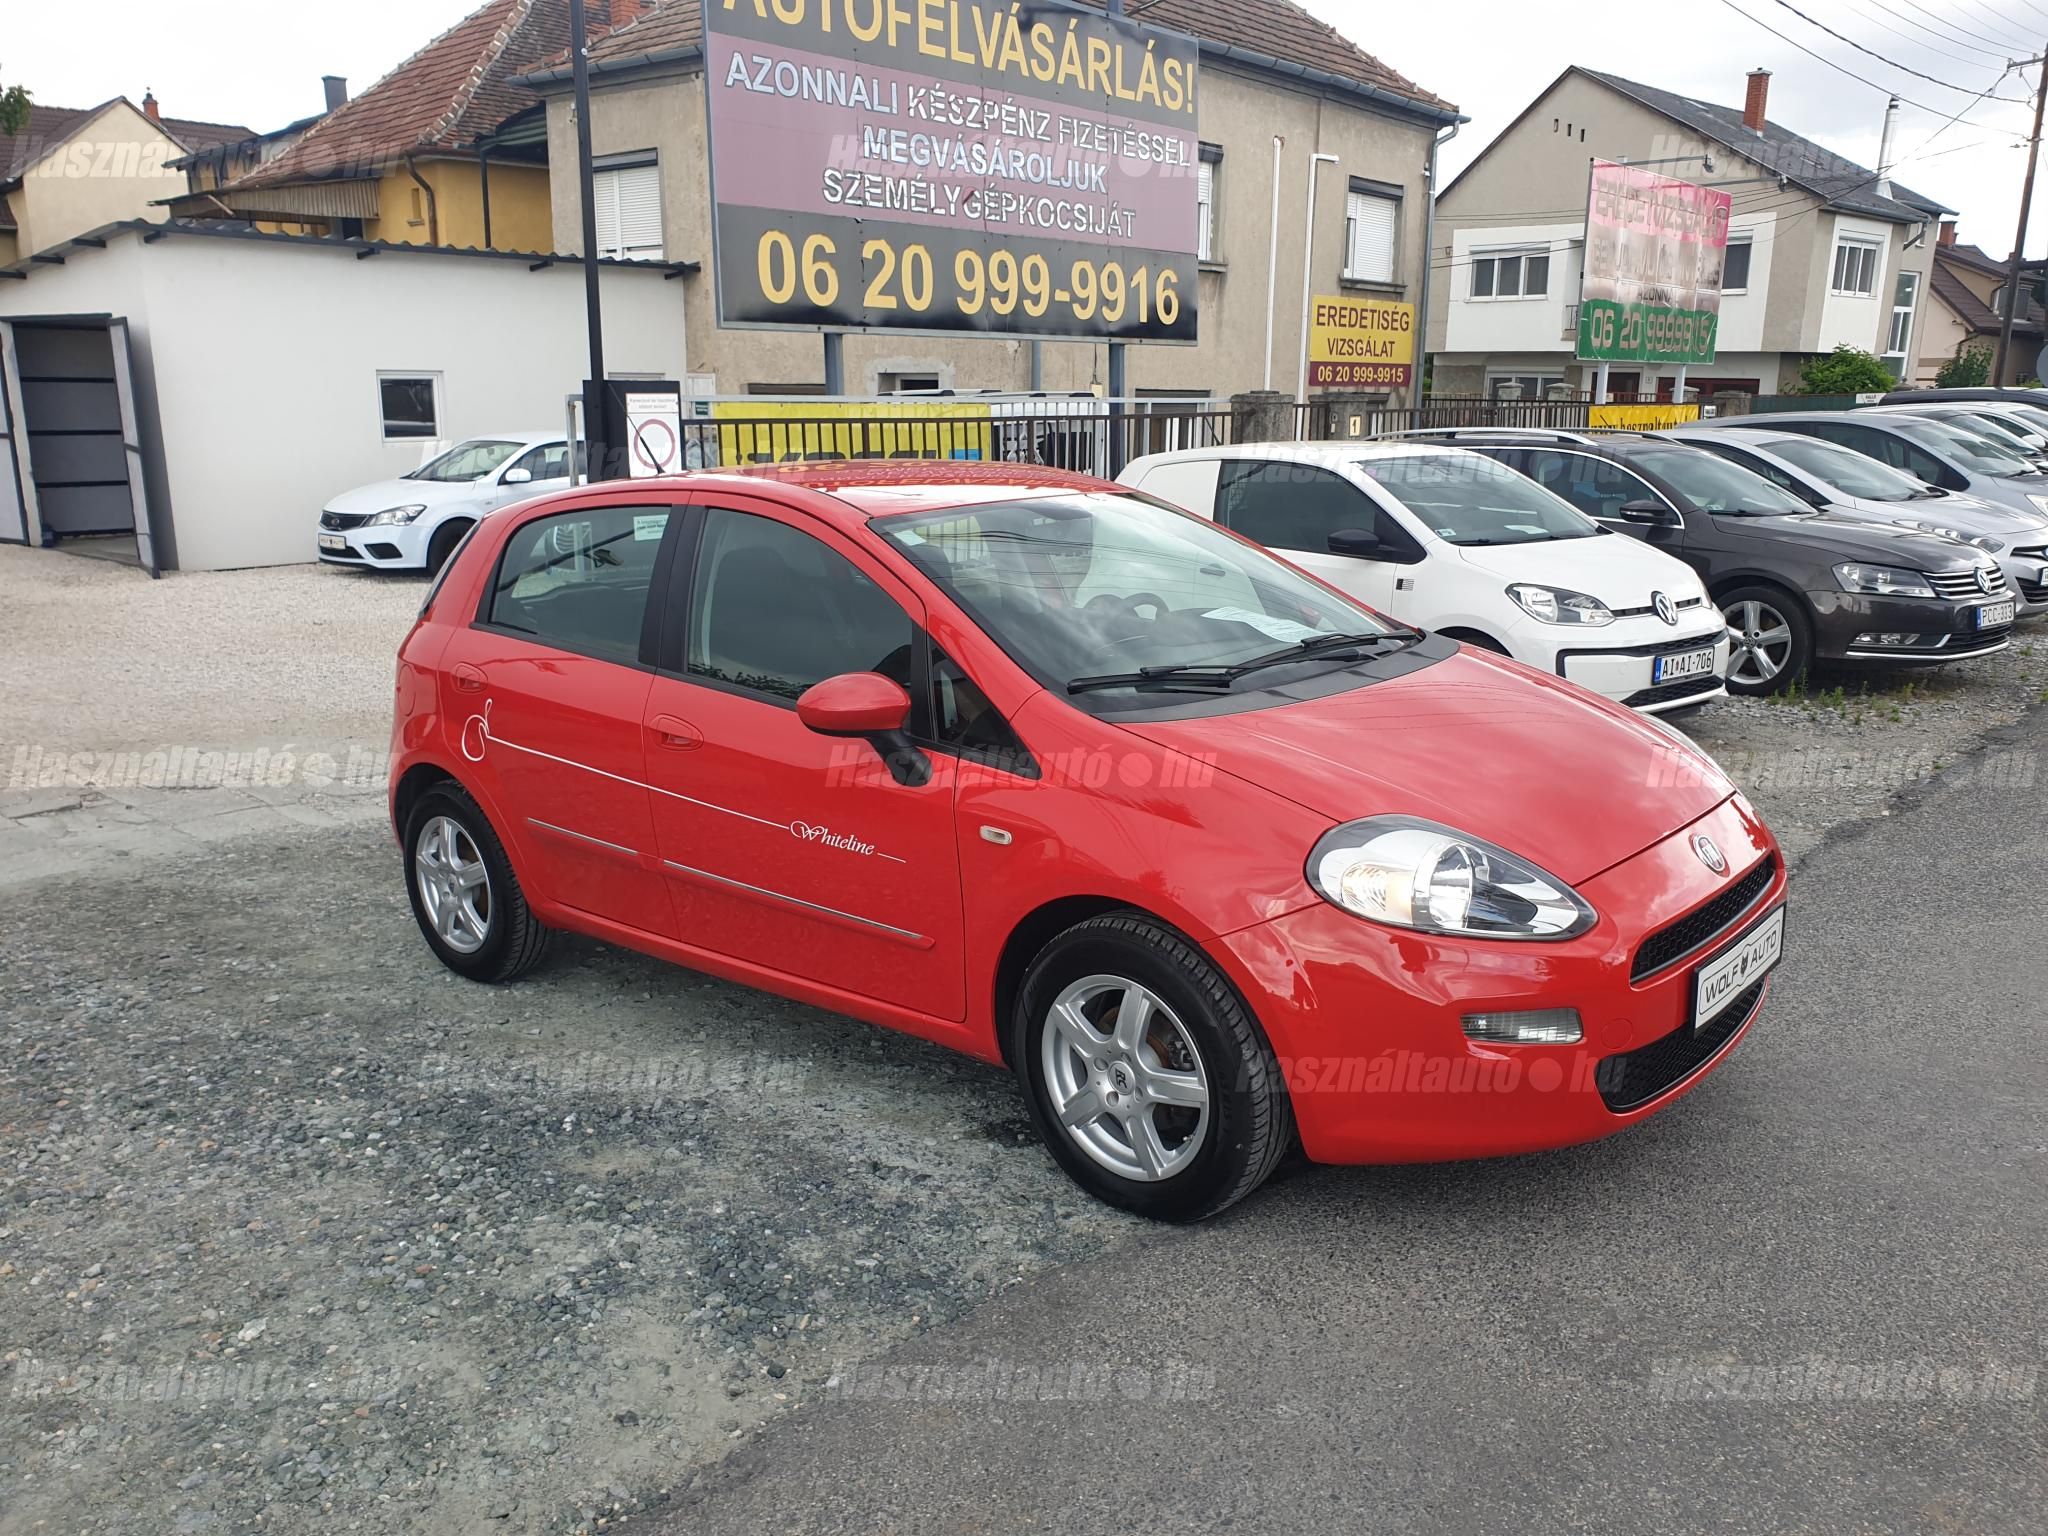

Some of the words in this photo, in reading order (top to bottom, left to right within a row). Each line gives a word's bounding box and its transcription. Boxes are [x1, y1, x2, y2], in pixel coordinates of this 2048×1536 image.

[721, 0, 1195, 114] OFELVÁSÁRLÁS!
[725, 52, 898, 114] AZONNALI
[908, 83, 1051, 141] KÉSZPÉNZ
[1058, 115, 1191, 167] FIZETÉSSEL
[863, 125, 1108, 194] MEGVÁSÁROLJUK
[823, 168, 1136, 238] SZEMÉLYGÉPKOCSIJÁT
[757, 230, 839, 307] 06
[862, 239, 933, 312] 20
[954, 249, 1179, 326] 999-9916
[1316, 305, 1410, 332] EREDETISÉG
[1591, 308, 1615, 348] 06
[1619, 311, 1641, 350] 20
[1317, 366, 1332, 382] 06
[1336, 366, 1350, 382] 20
[1353, 367, 1404, 383] 999-9915
[1327, 336, 1396, 358] VIZSGÁLAT
[1680, 651, 1712, 673] AI-706
[790, 820, 875, 855] Whiteline
[1705, 964, 1739, 1003] WOLF
[1750, 930, 1777, 968] AUTO
